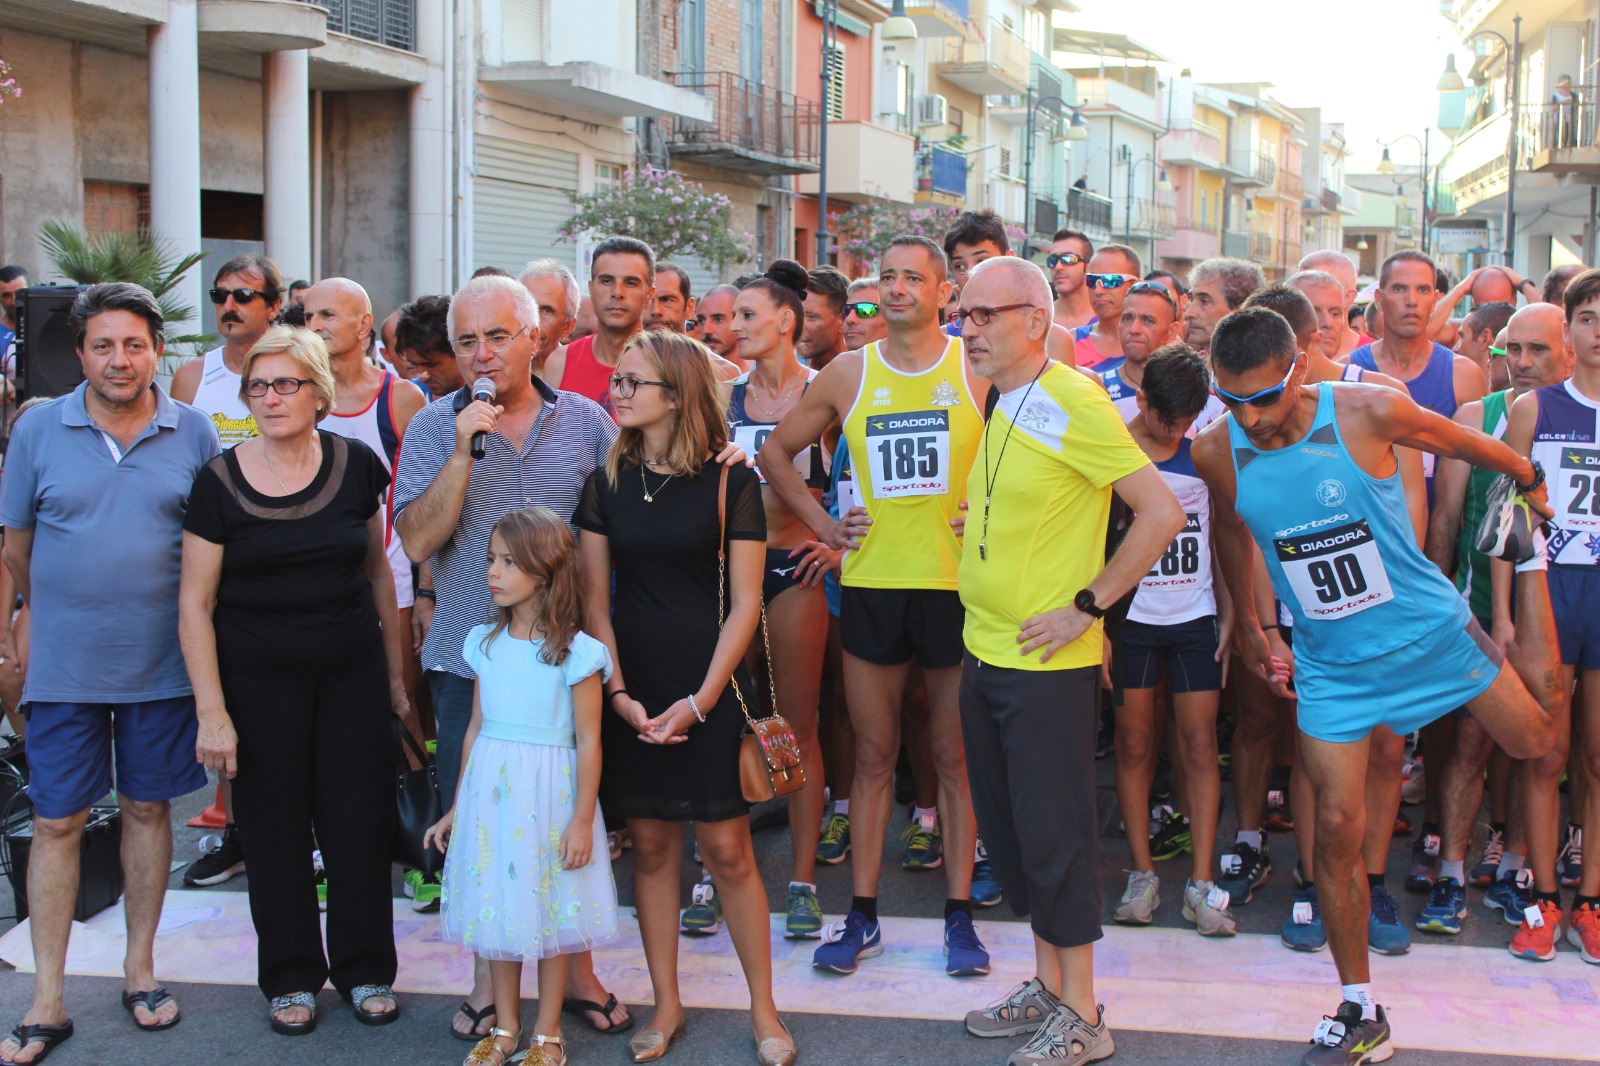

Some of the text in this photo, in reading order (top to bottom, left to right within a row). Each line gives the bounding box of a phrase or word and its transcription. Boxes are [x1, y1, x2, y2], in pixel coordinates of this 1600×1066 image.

[888, 417, 946, 430] DIADORA
[878, 436, 939, 482] 185
[1300, 446, 1340, 459] DIADORA
[882, 481, 942, 493] sportado
[1274, 513, 1350, 538] sportado
[1300, 529, 1367, 553] DIADORA
[1148, 536, 1199, 577] 88
[1142, 577, 1197, 588] sportado
[1307, 552, 1367, 604] 90
[1313, 592, 1381, 615] sportado
